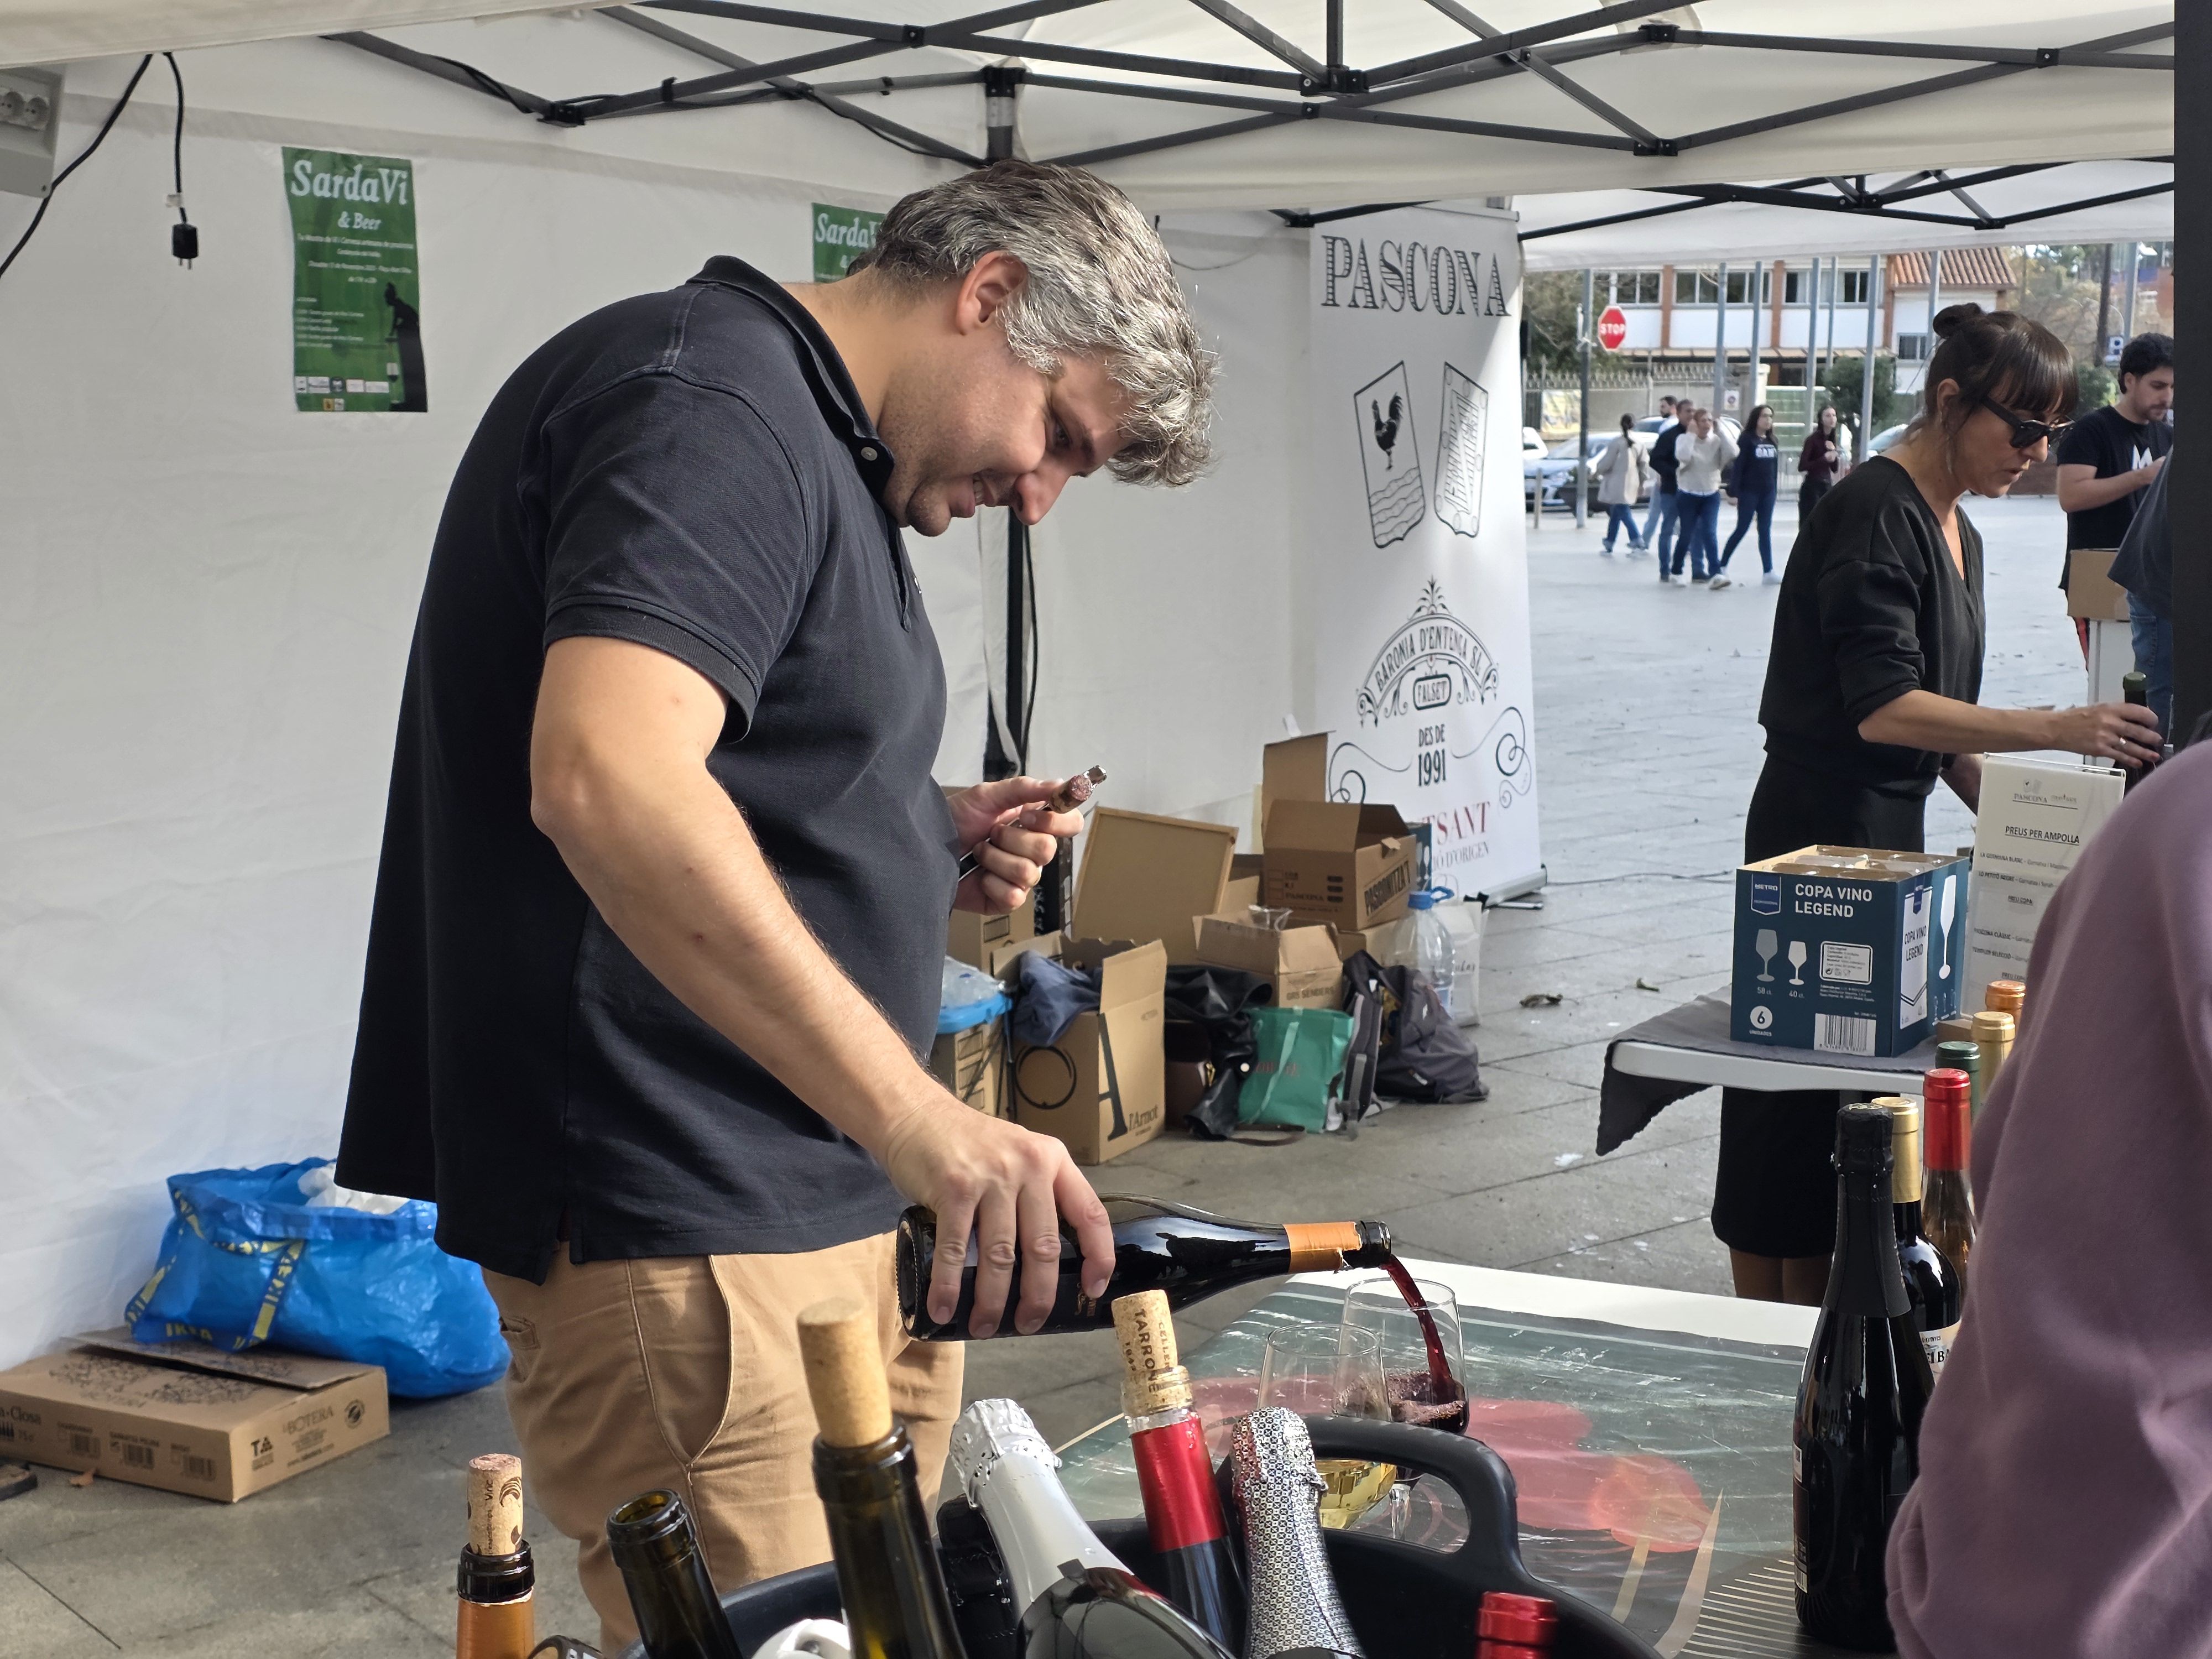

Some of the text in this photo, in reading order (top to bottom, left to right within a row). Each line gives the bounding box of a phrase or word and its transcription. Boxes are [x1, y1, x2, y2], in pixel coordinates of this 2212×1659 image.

[290, 159, 408, 205] SardaVi
[338, 211, 382, 230] & Beer
[1321, 235, 1511, 317] PASCONA
[1600, 323, 1625, 335] STOP
[1375, 634, 1415, 692] BARONIA
[1470, 646, 1482, 676] SL
[1417, 681, 1447, 704] FALSET
[1418, 724, 1445, 747] DES DE
[1418, 749, 1446, 787] 1991
[1422, 801, 1490, 845] SANT
[2006, 826, 2079, 843] PREUS PER AMPOLLA
[1796, 883, 1872, 902] COPA VINO
[1795, 900, 1854, 918] LEGEND
[1905, 925, 1927, 945] COPA VINO
[1906, 943, 1923, 962] LEGEND
[1757, 1011, 1765, 1024] 6
